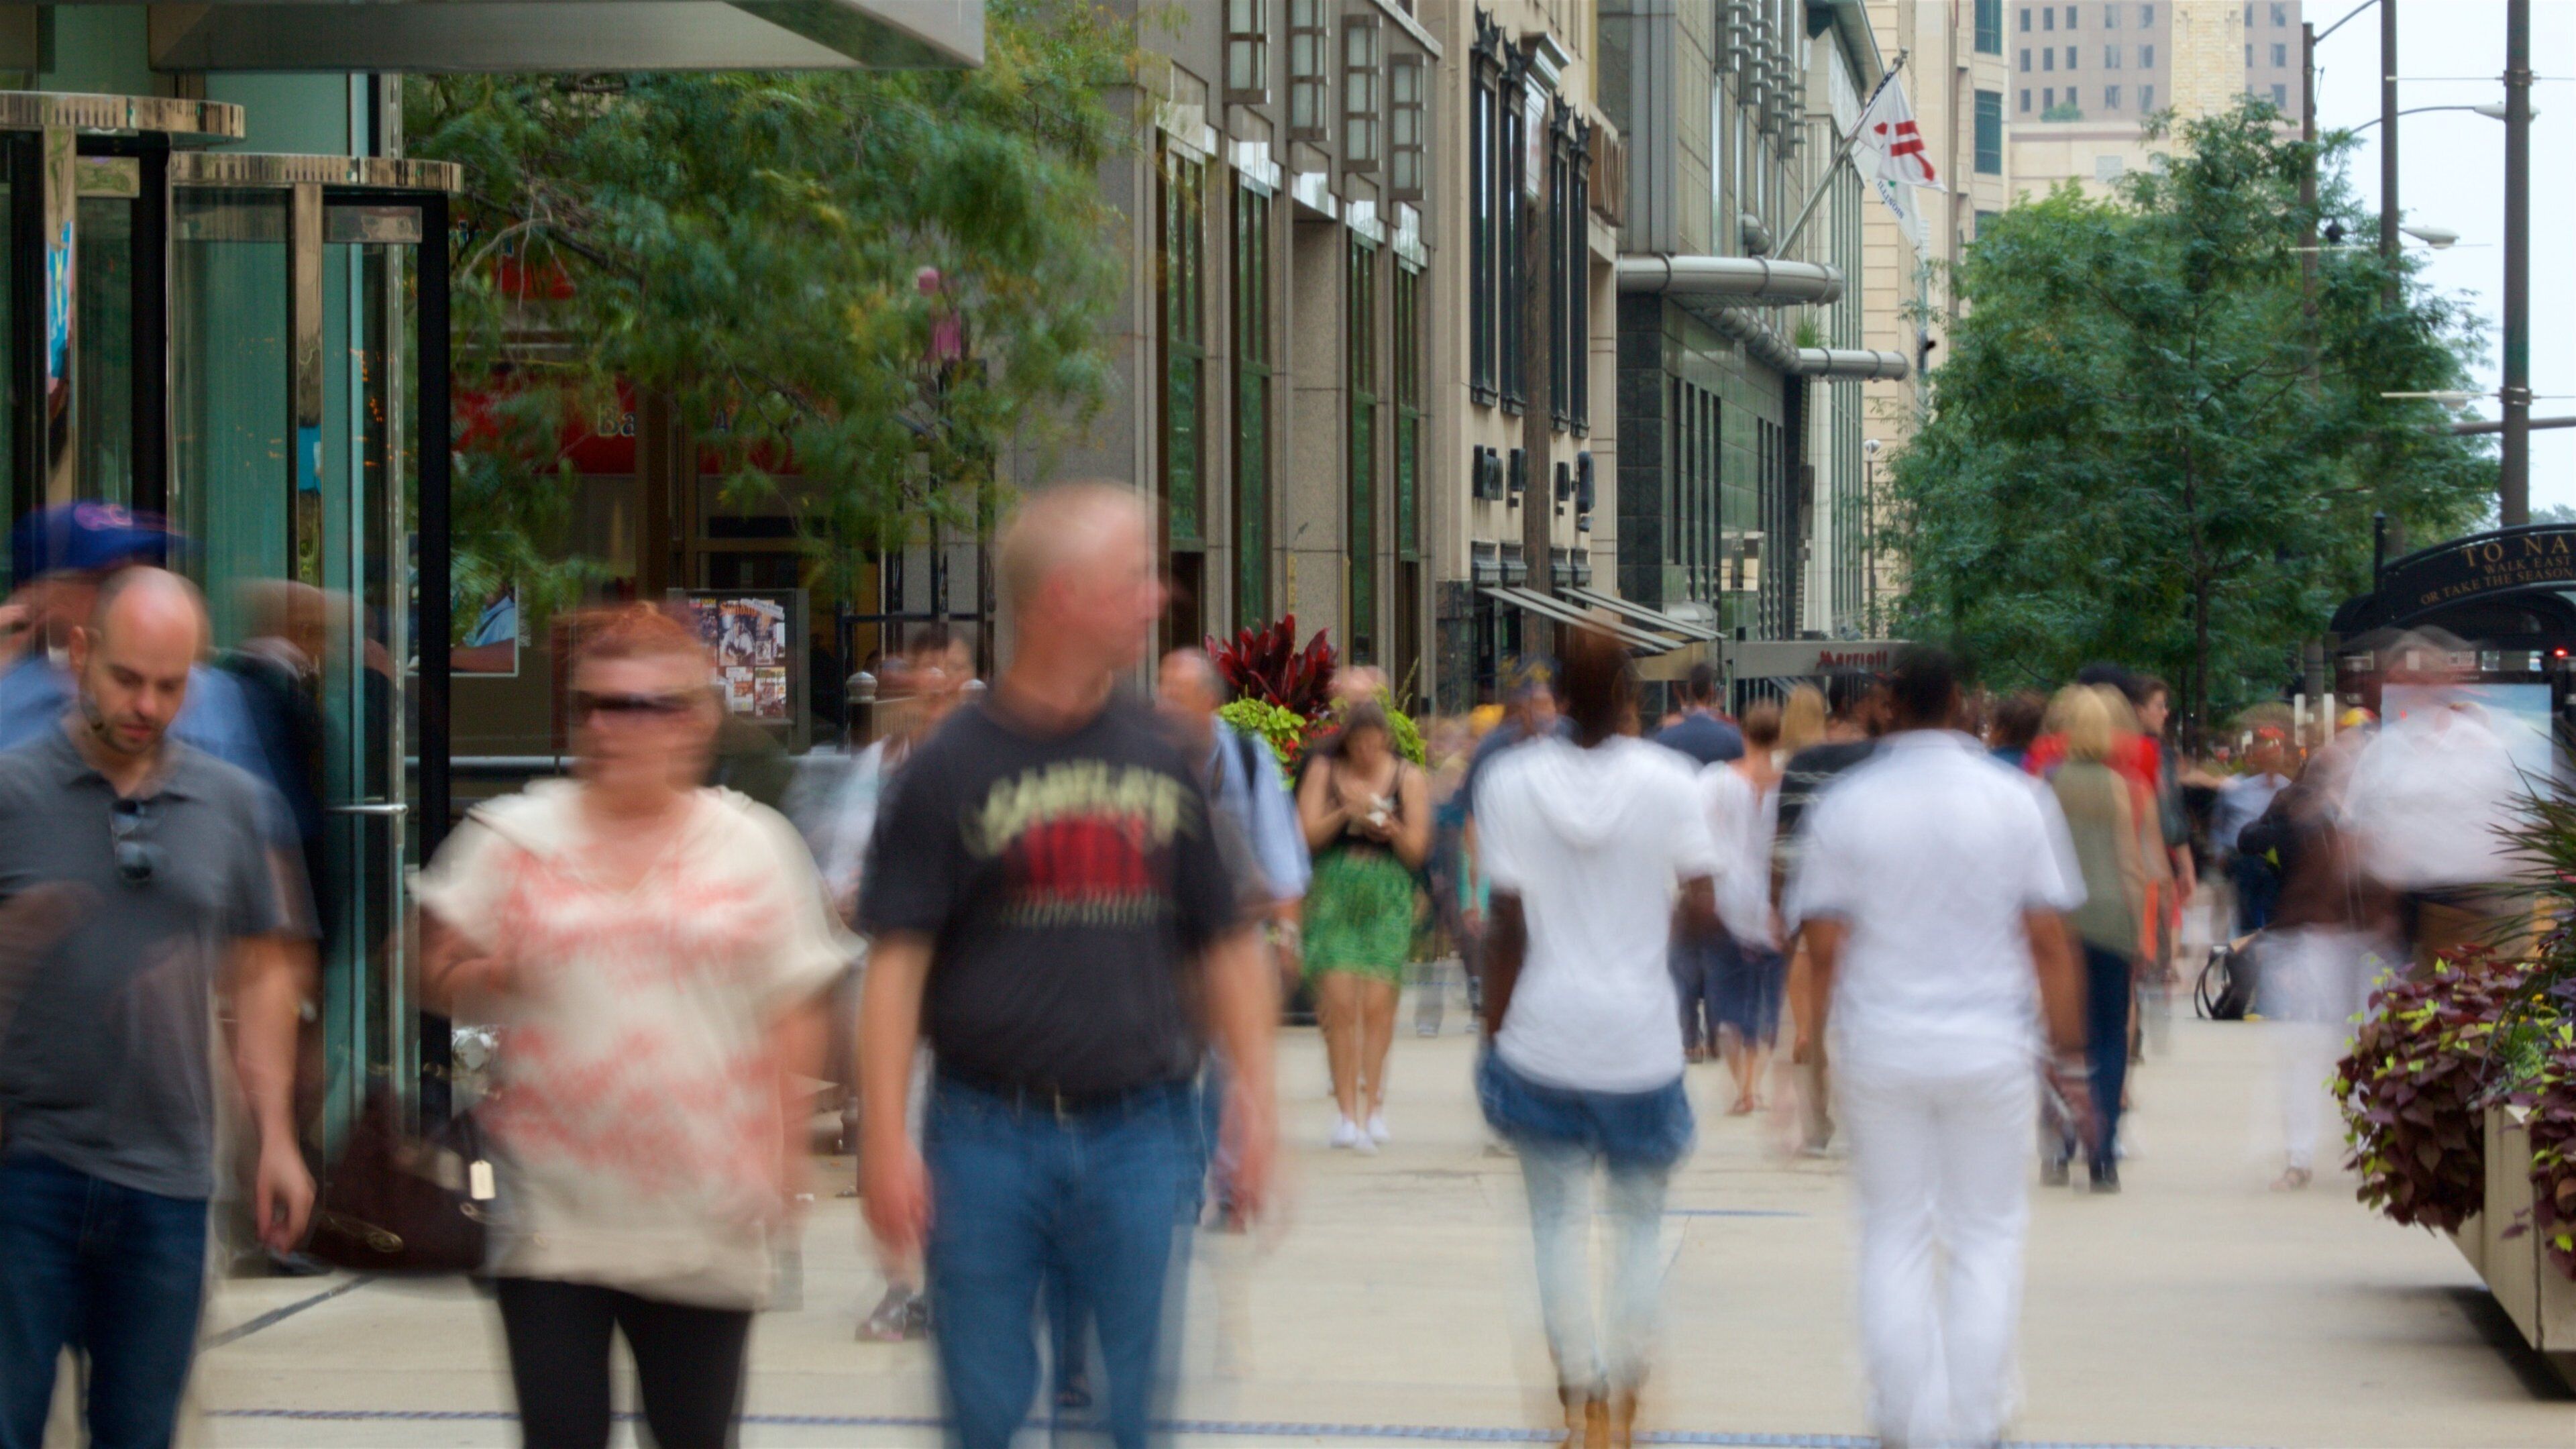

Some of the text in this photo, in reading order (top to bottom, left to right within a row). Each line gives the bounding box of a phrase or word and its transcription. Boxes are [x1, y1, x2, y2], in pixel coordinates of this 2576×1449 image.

[1877, 180, 1904, 219] ILLINOIS
[598, 402, 636, 437] Ba
[2461, 535, 2570, 568] TO NA
[2484, 555, 2571, 574] WALK EAST
[2420, 567, 2576, 605] OR TAKE THE SEASON
[1815, 649, 1888, 669] Marriott
